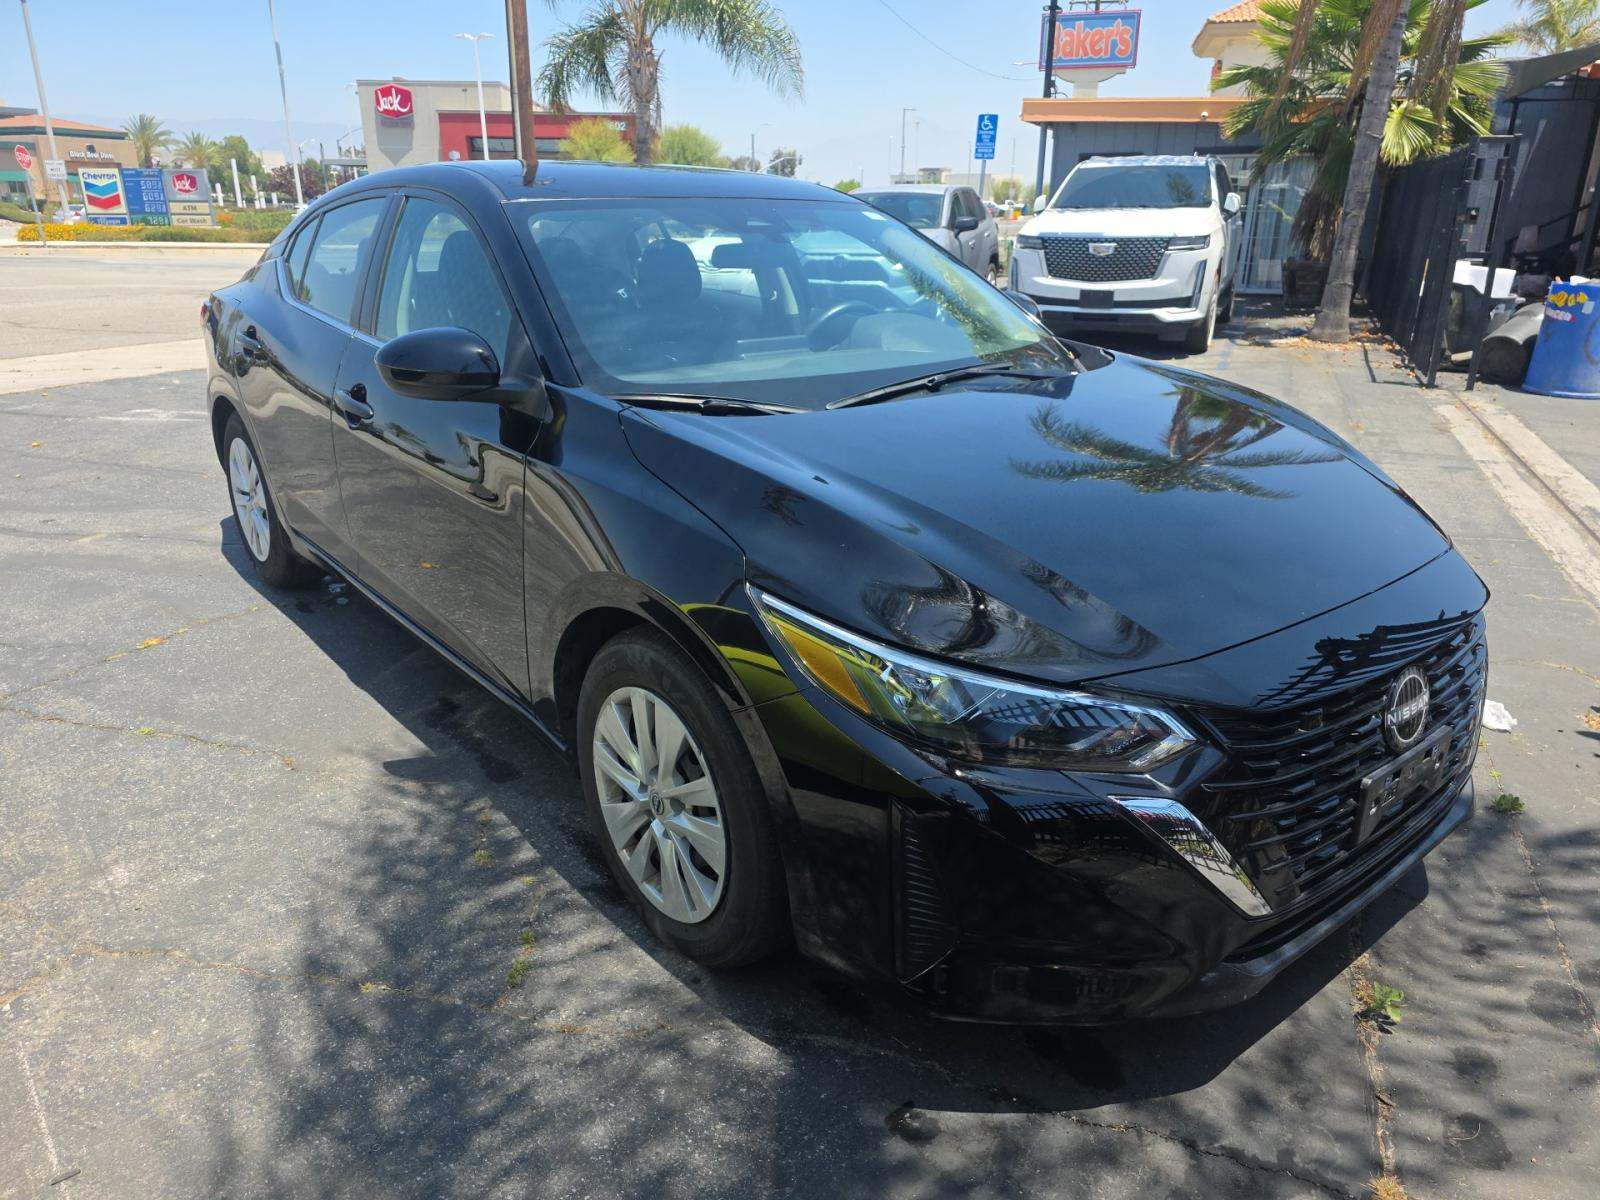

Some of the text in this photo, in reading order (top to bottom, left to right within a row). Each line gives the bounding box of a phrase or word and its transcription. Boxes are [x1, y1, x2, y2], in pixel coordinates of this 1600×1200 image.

[377, 87, 411, 112] Jack
[16, 150, 32, 162] STOP
[82, 171, 117, 180] Chevron
[173, 174, 199, 191] Jack
[1387, 694, 1429, 725] NISSAN
